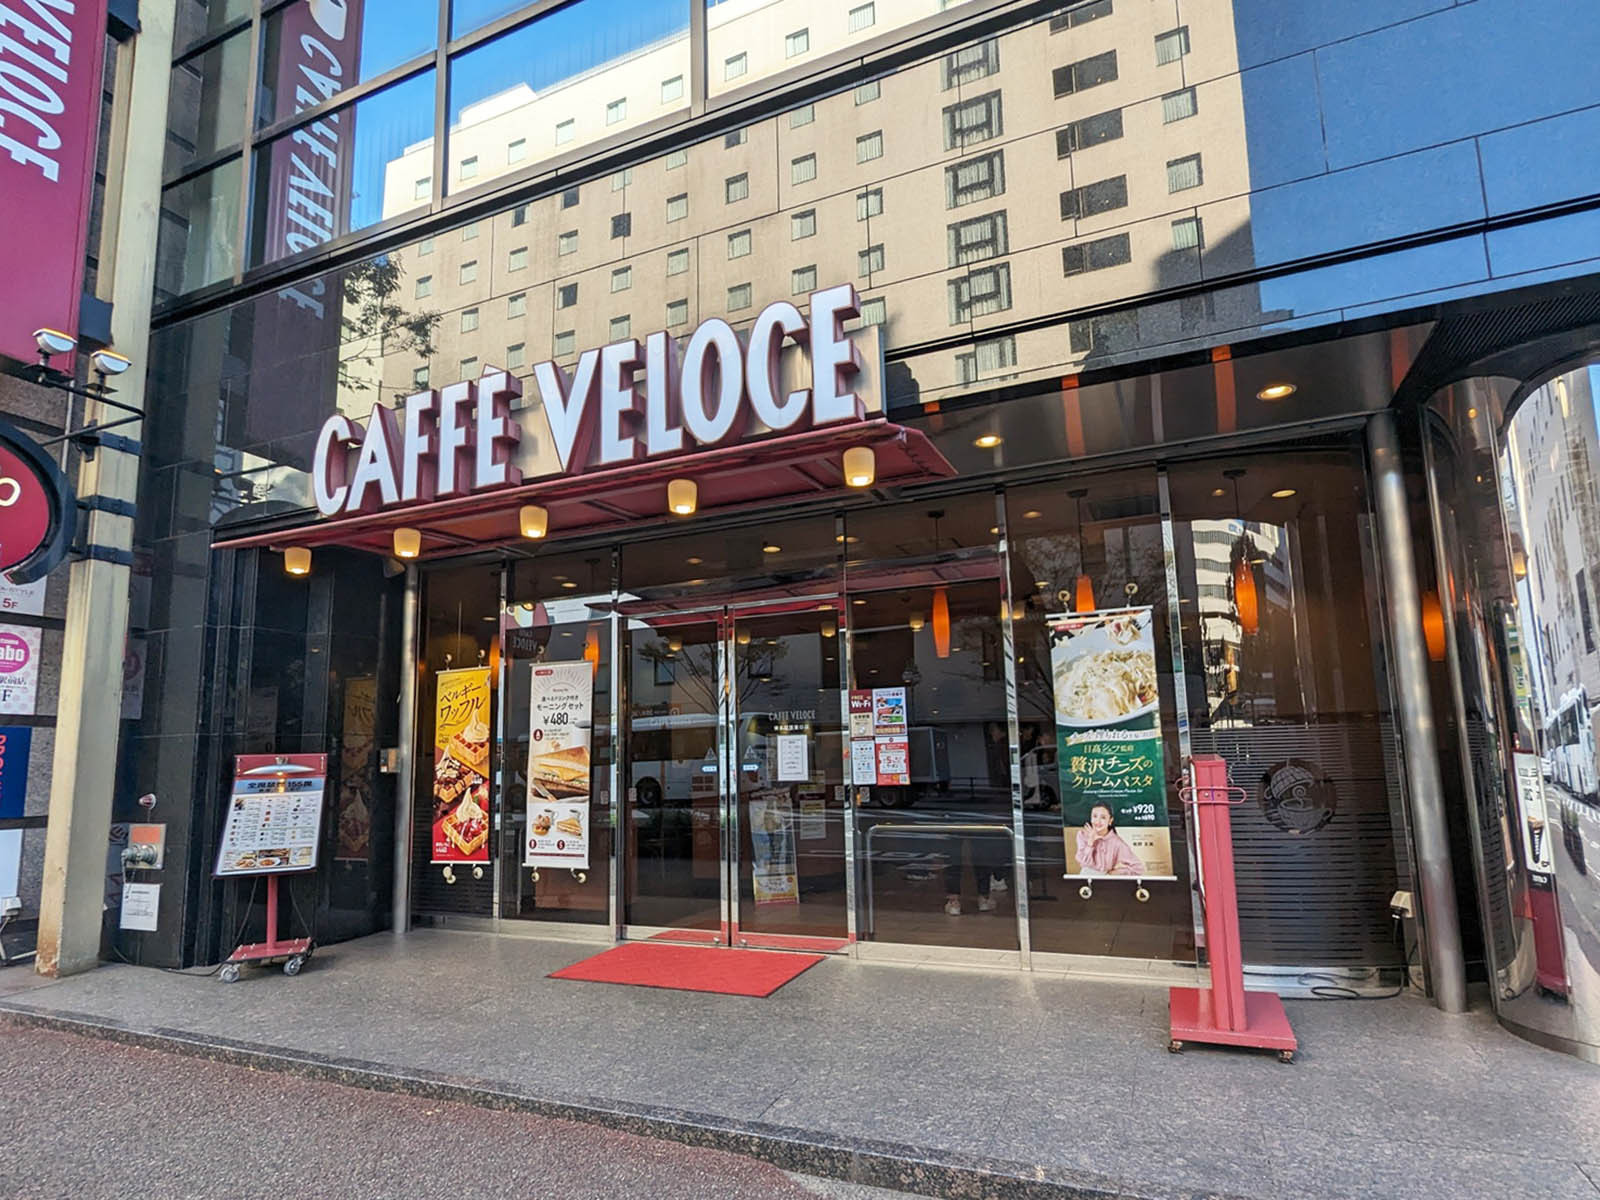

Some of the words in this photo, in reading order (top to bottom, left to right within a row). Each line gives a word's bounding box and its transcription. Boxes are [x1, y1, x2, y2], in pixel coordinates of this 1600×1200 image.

[532, 283, 857, 473] VELOCE
[2, 597, 18, 609] 5F
[440, 682, 481, 703] ベルギー
[440, 696, 486, 723] ワッフル
[536, 702, 584, 711] モーニングセット
[850, 699, 872, 708] Wi-Fi
[543, 712, 569, 726] ¥480
[790, 709, 816, 720] VELOCE
[1071, 755, 1154, 776] 贅沢チーズの
[1071, 774, 1154, 789] クリームパスタ
[1132, 803, 1155, 814] ¥920
